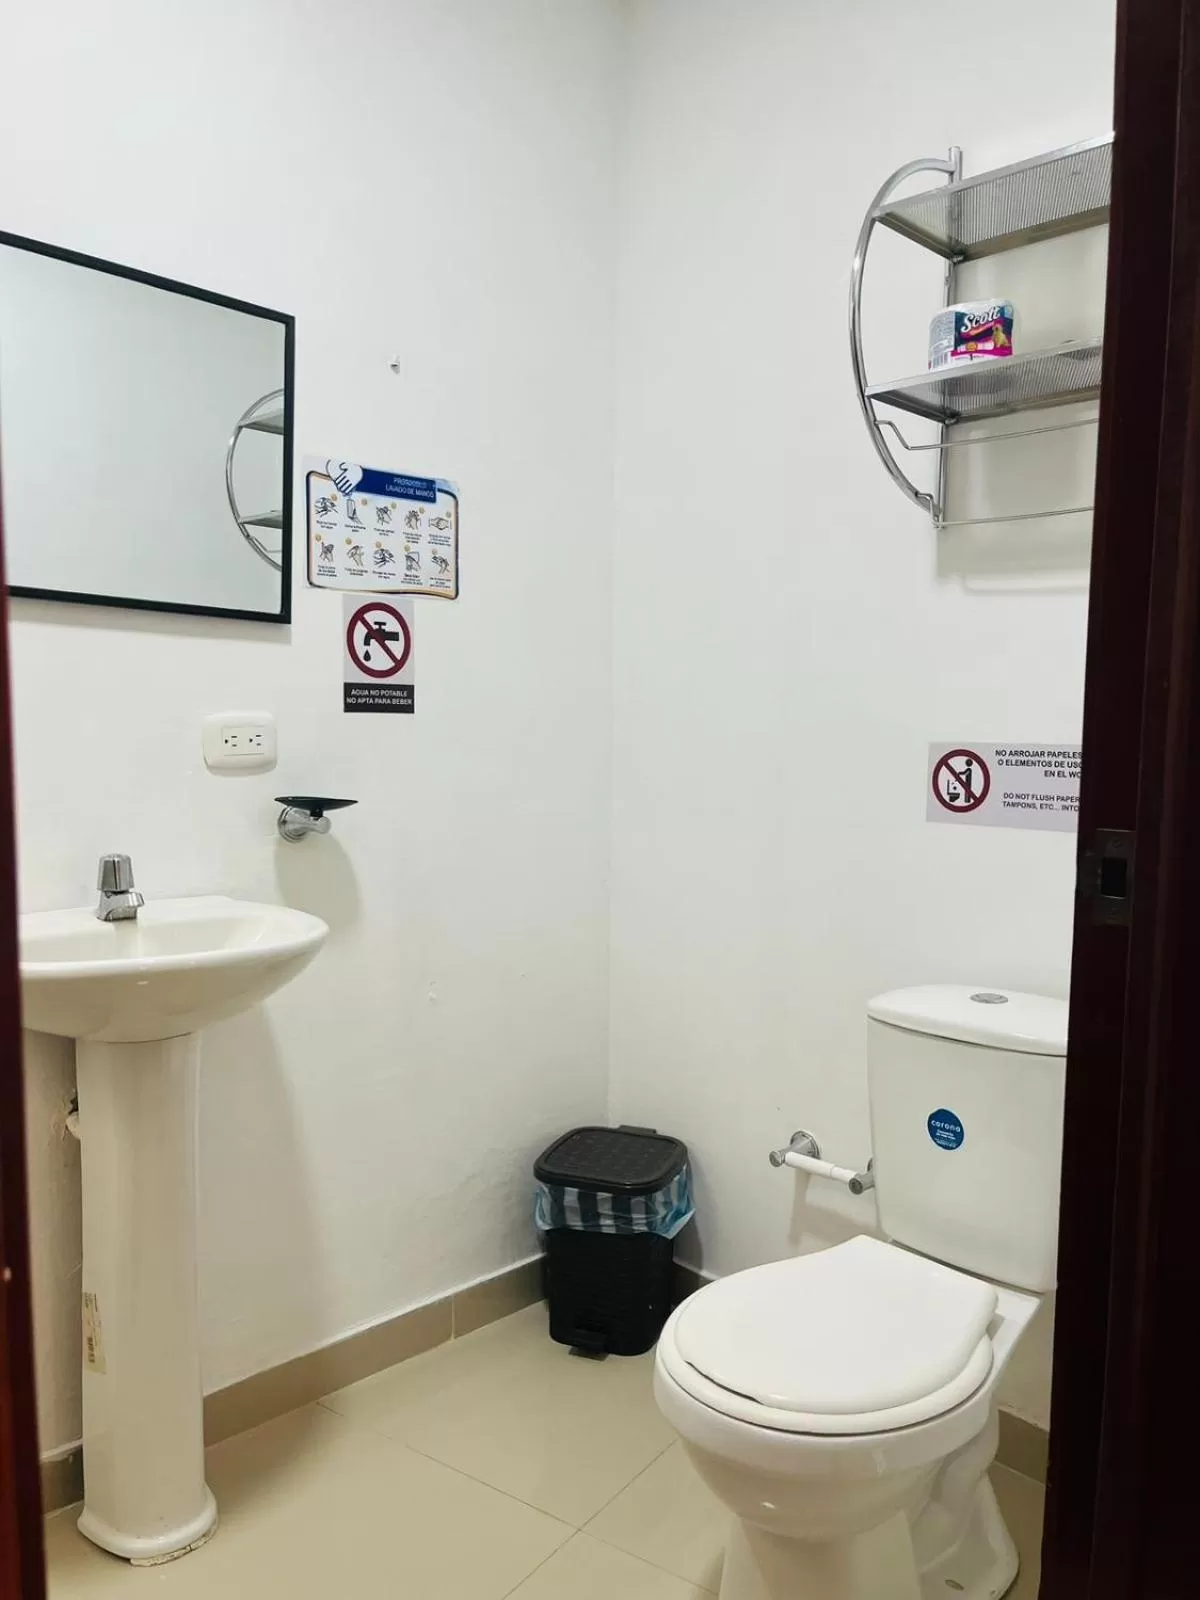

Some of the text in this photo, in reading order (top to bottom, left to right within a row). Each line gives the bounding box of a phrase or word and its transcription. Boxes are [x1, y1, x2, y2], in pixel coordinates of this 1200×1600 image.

[961, 305, 1000, 332] Scott
[995, 749, 1083, 759] NO ARROJAR PAPELES
[1005, 759, 1053, 768] ELEMENTOS
[1054, 760, 1065, 768] DE
[1044, 770, 1055, 778] EN
[1057, 770, 1067, 778] EL
[1003, 792, 1014, 800] DO
[1003, 801, 1038, 810] TAMPONS,
[931, 1120, 960, 1132] corona
